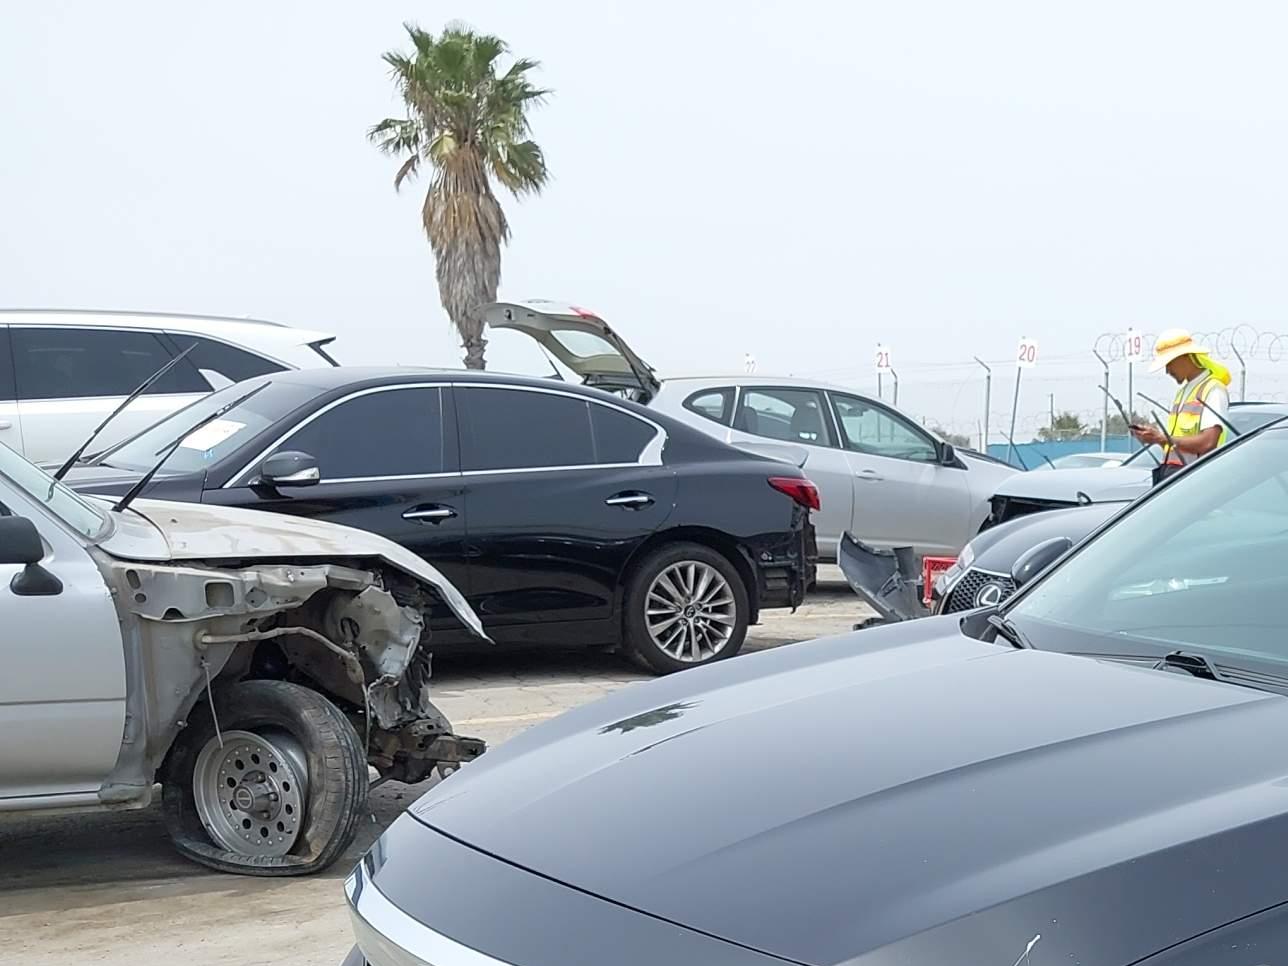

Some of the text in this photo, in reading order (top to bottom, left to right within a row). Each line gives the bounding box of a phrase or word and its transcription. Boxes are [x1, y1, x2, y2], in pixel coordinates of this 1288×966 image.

[1018, 343, 1036, 363] 20
[1127, 336, 1141, 356] 19
[876, 351, 890, 368] 21
